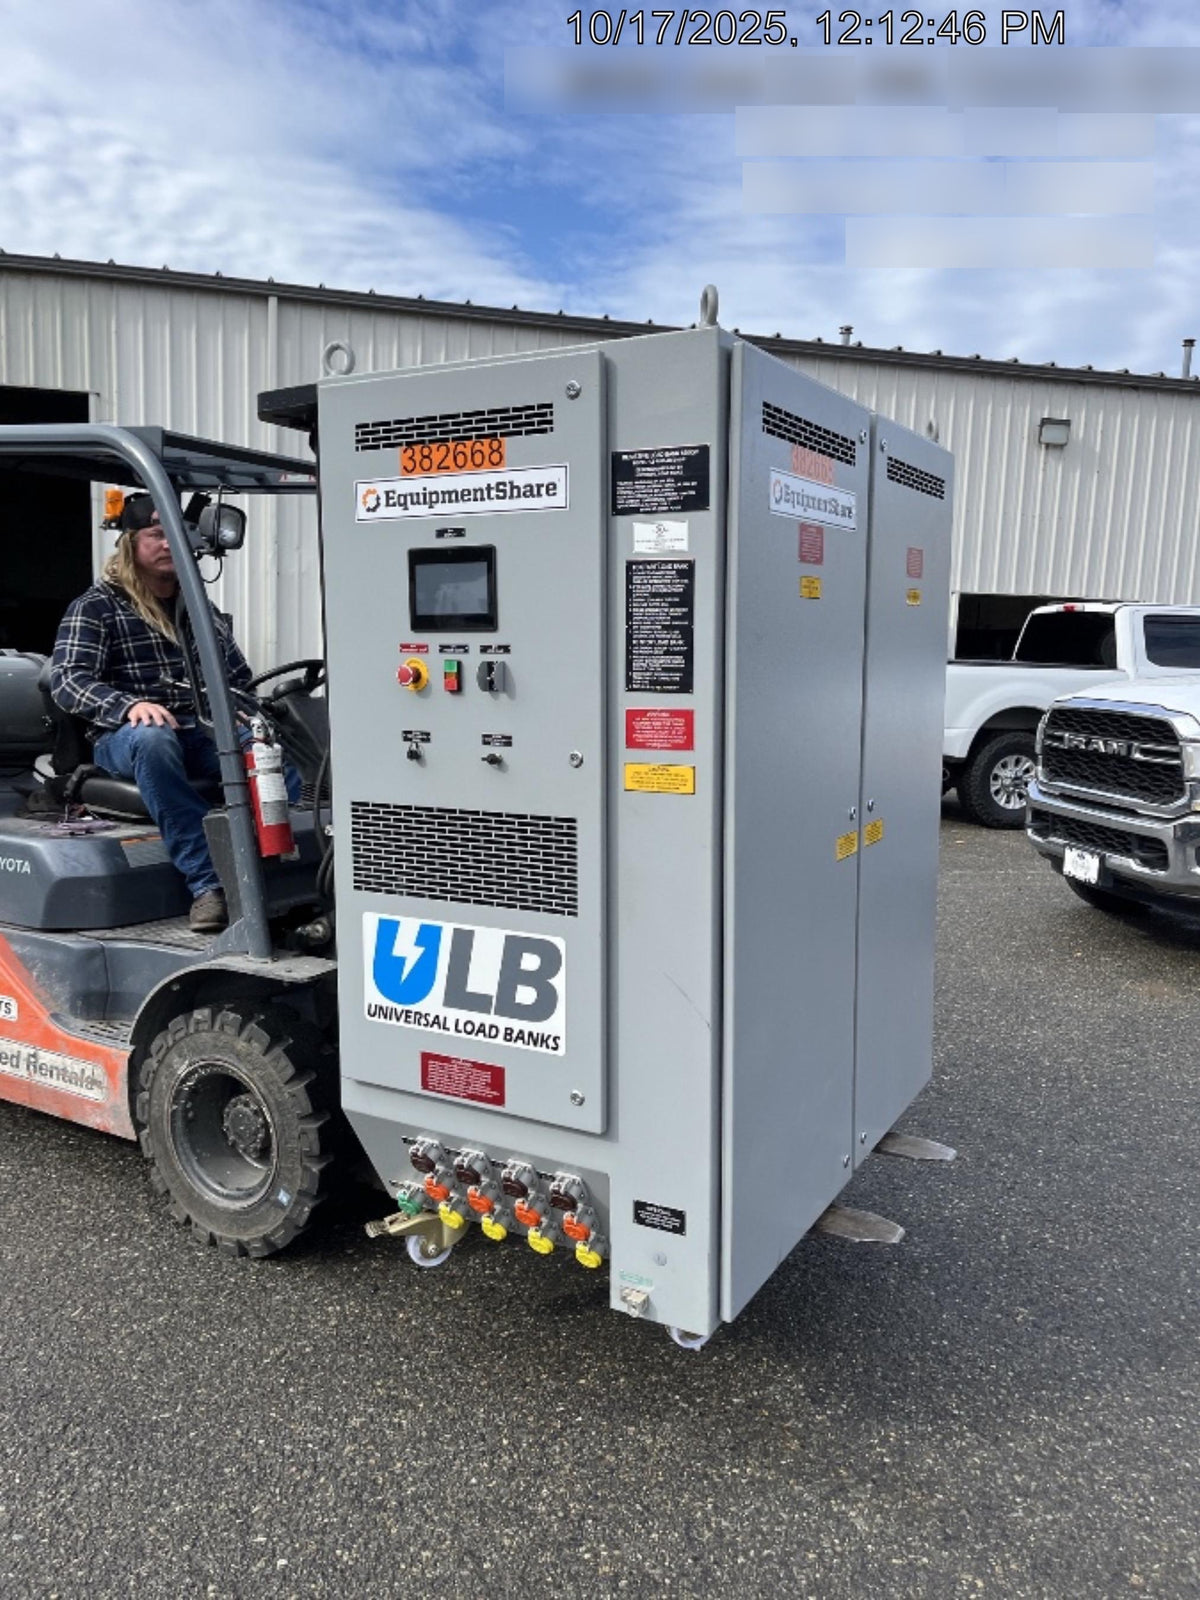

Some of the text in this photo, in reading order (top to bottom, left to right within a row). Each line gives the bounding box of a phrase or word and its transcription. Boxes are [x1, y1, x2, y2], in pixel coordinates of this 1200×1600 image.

[403, 438, 504, 473] 382668
[384, 481, 557, 510] EquipmentShare
[1064, 733, 1127, 755] RAM
[373, 917, 562, 1023] ULB
[367, 1003, 560, 1052] UNIVERSAL LOAD BANKS
[26, 1052, 96, 1090] Rentals
